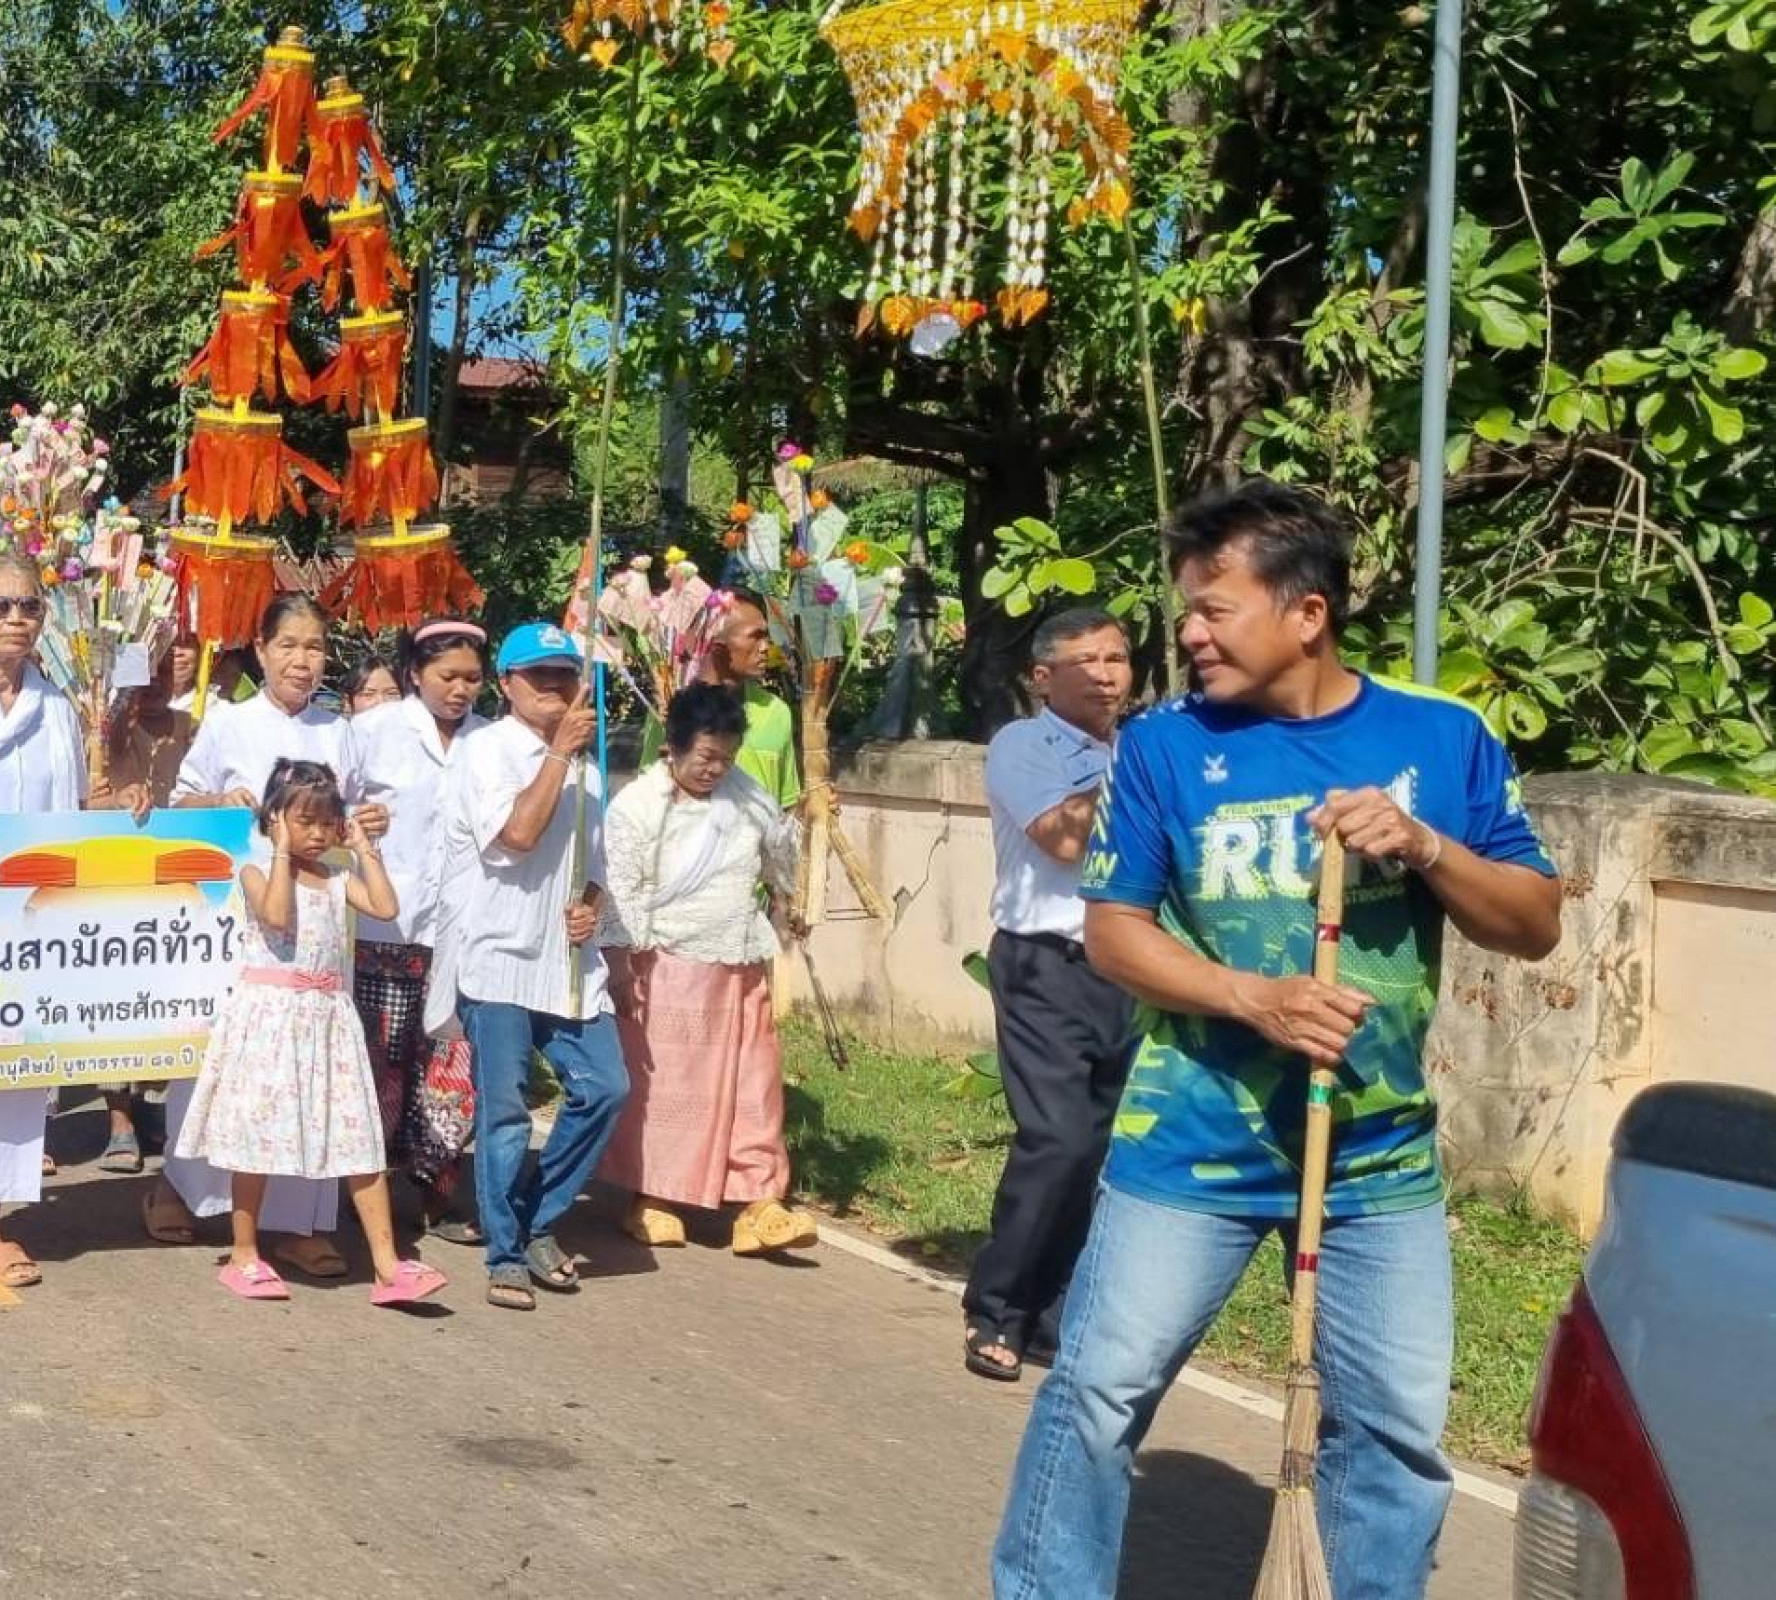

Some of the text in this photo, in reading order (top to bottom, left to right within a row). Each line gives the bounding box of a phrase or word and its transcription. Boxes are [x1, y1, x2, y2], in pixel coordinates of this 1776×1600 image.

[35, 997, 69, 1026] วัด
[78, 992, 215, 1033] พุทธศักราช
